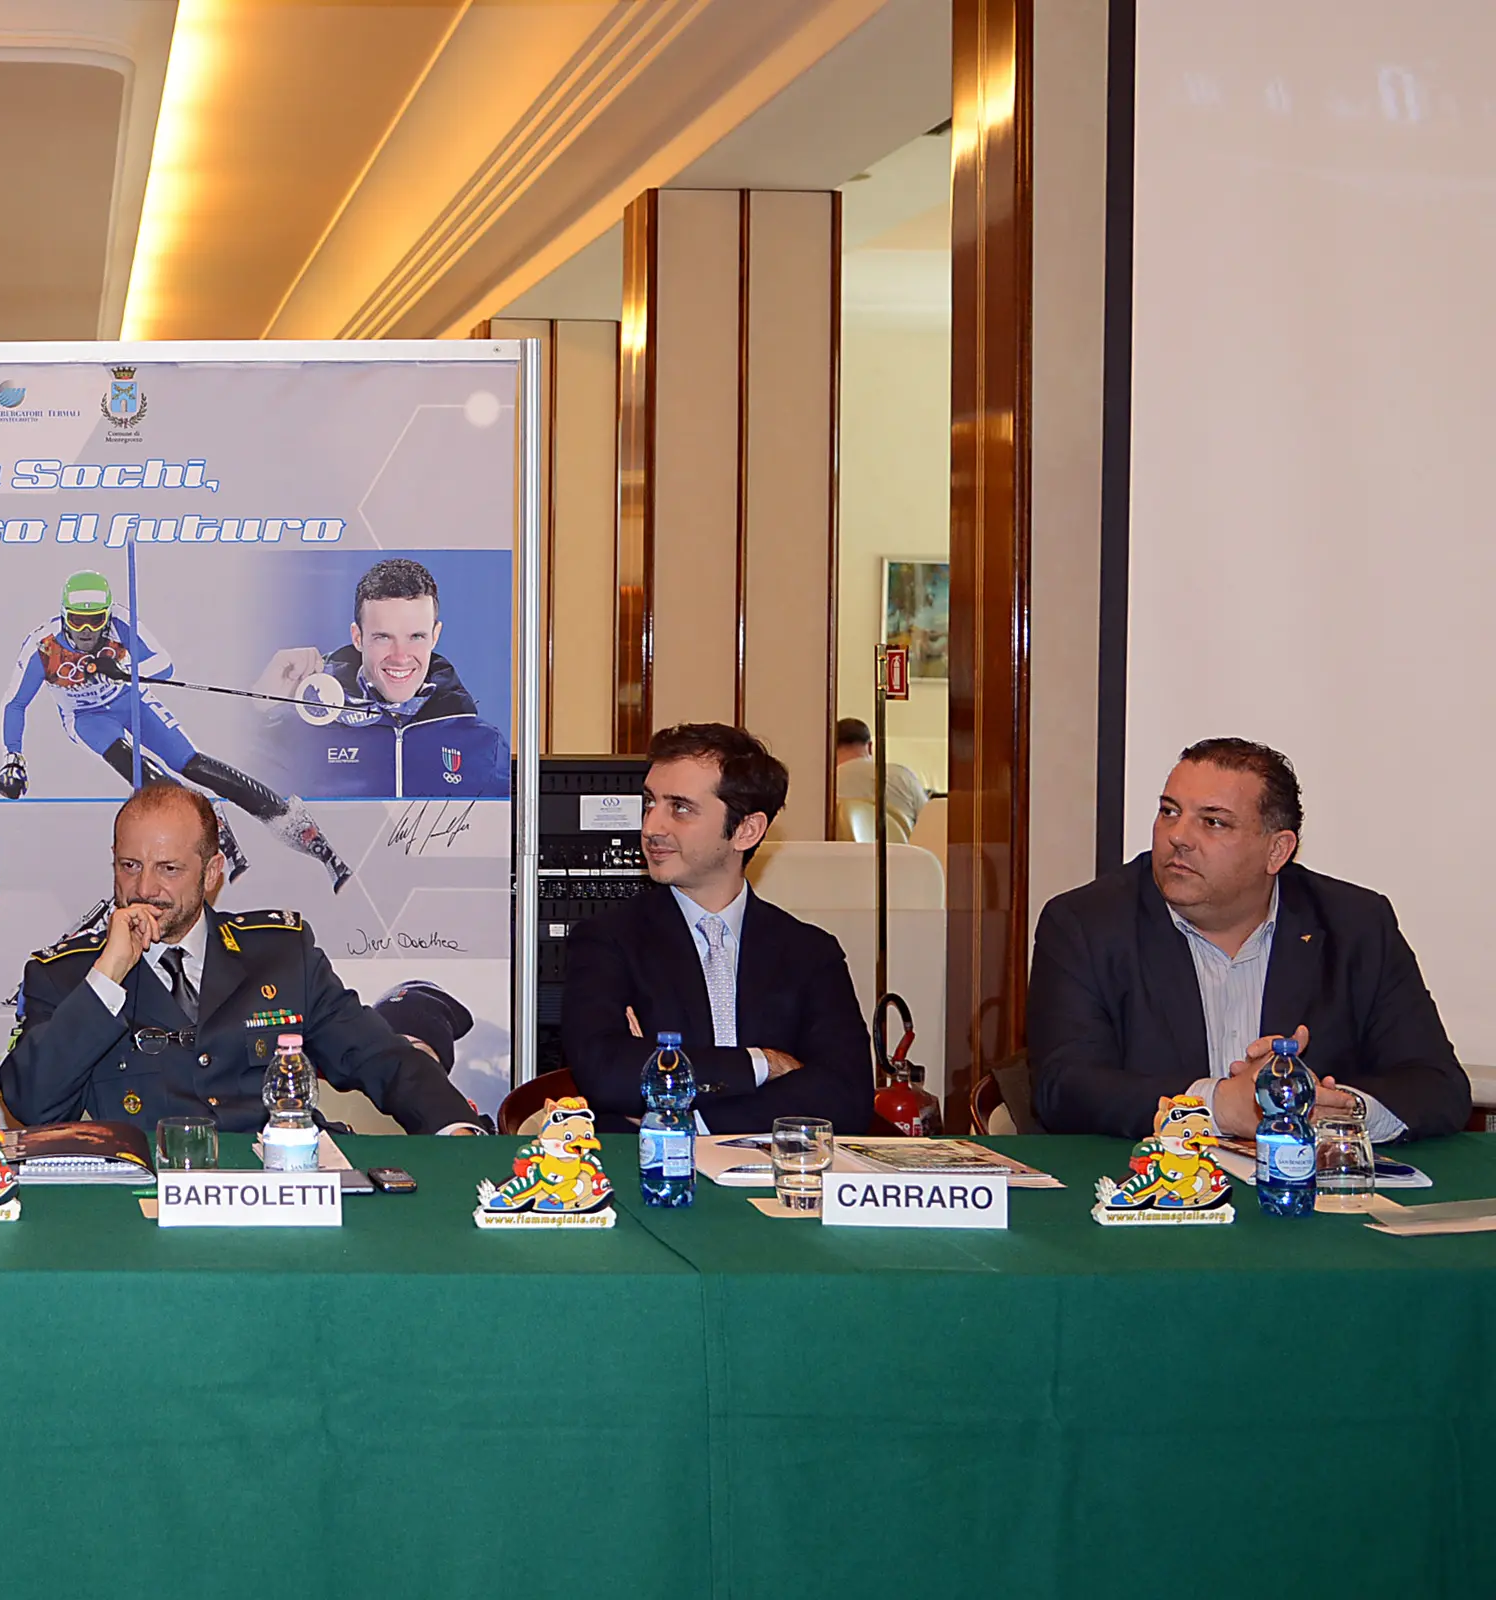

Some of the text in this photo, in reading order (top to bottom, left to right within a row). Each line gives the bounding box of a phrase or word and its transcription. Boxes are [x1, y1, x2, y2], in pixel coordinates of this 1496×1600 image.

[10, 458, 220, 493] Sochi,
[55, 513, 99, 543] il
[103, 514, 347, 548] futuro
[327, 747, 359, 760] EA7
[164, 1185, 336, 1206] BARTOLETTI
[837, 1184, 993, 1209] CARRARO
[484, 1214, 608, 1227] www.fiammegialle.org
[1106, 1210, 1227, 1223] www.fiammegialle.org
